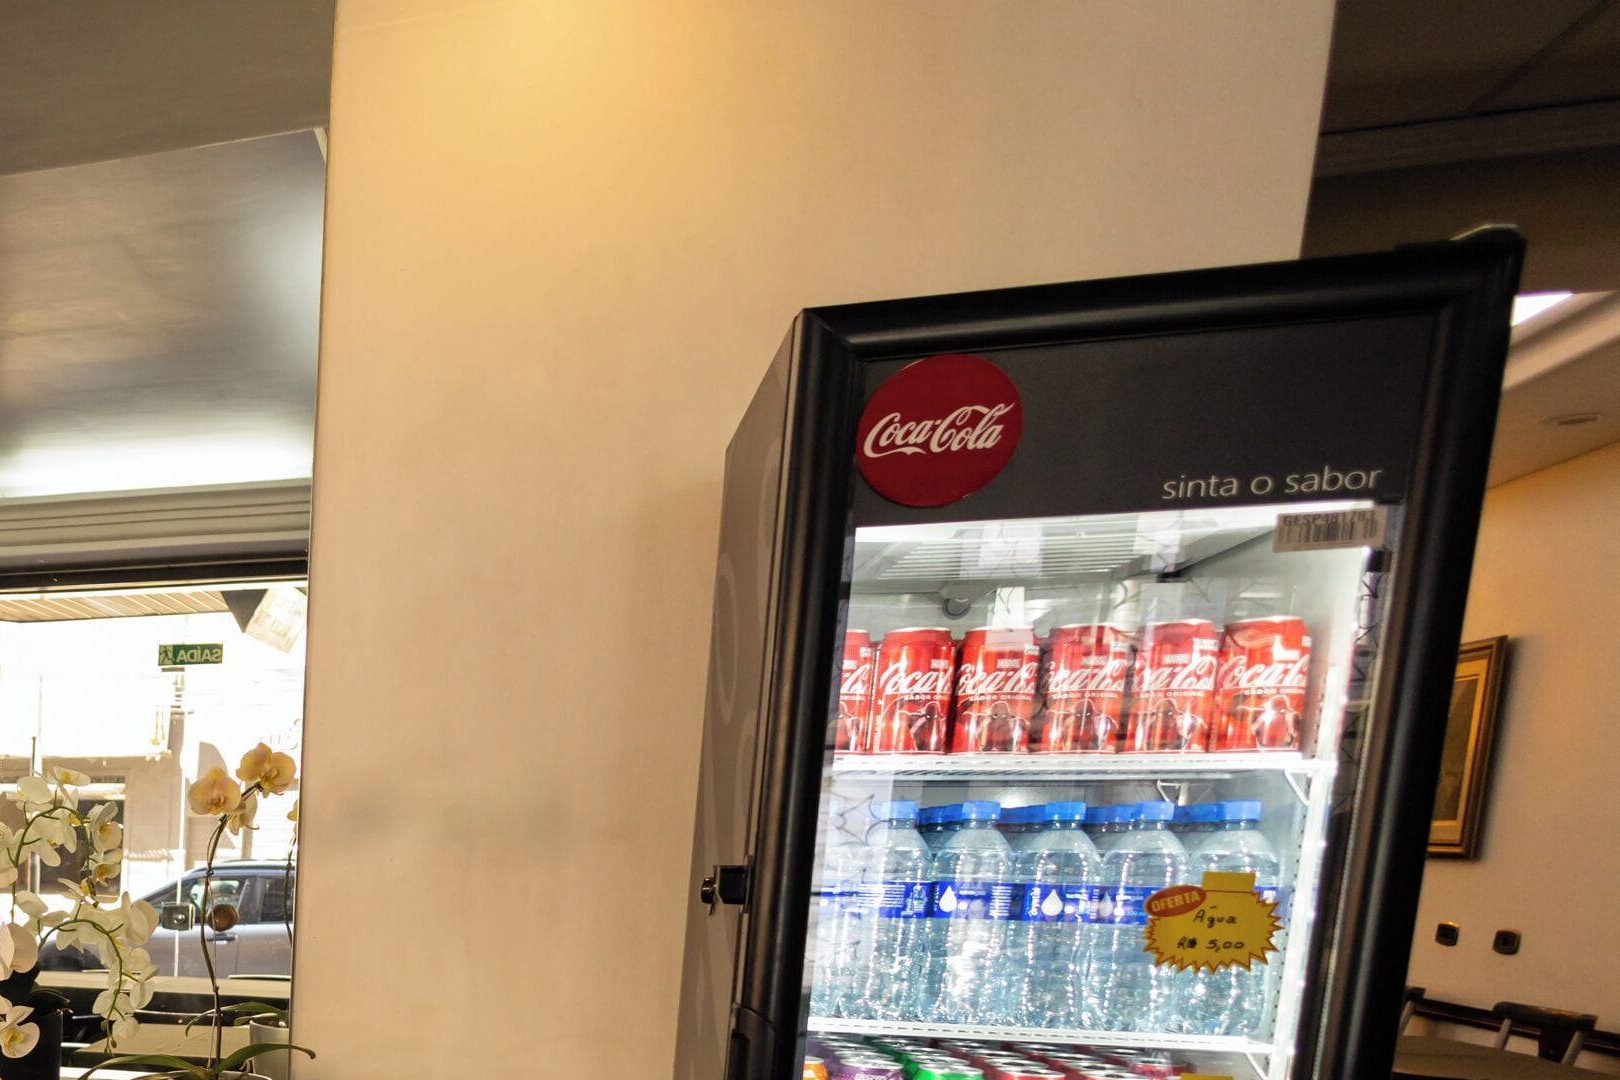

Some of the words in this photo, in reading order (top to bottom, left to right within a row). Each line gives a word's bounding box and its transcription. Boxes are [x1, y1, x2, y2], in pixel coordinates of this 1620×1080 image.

[863, 402, 1016, 458] Coca-Cola
[1162, 474, 1238, 500] sinta
[1250, 476, 1272, 495] o
[1283, 465, 1383, 493] sabor
[1151, 889, 1201, 913] OFERTA
[1193, 904, 1238, 929] Água
[1205, 938, 1246, 953] 5,00
